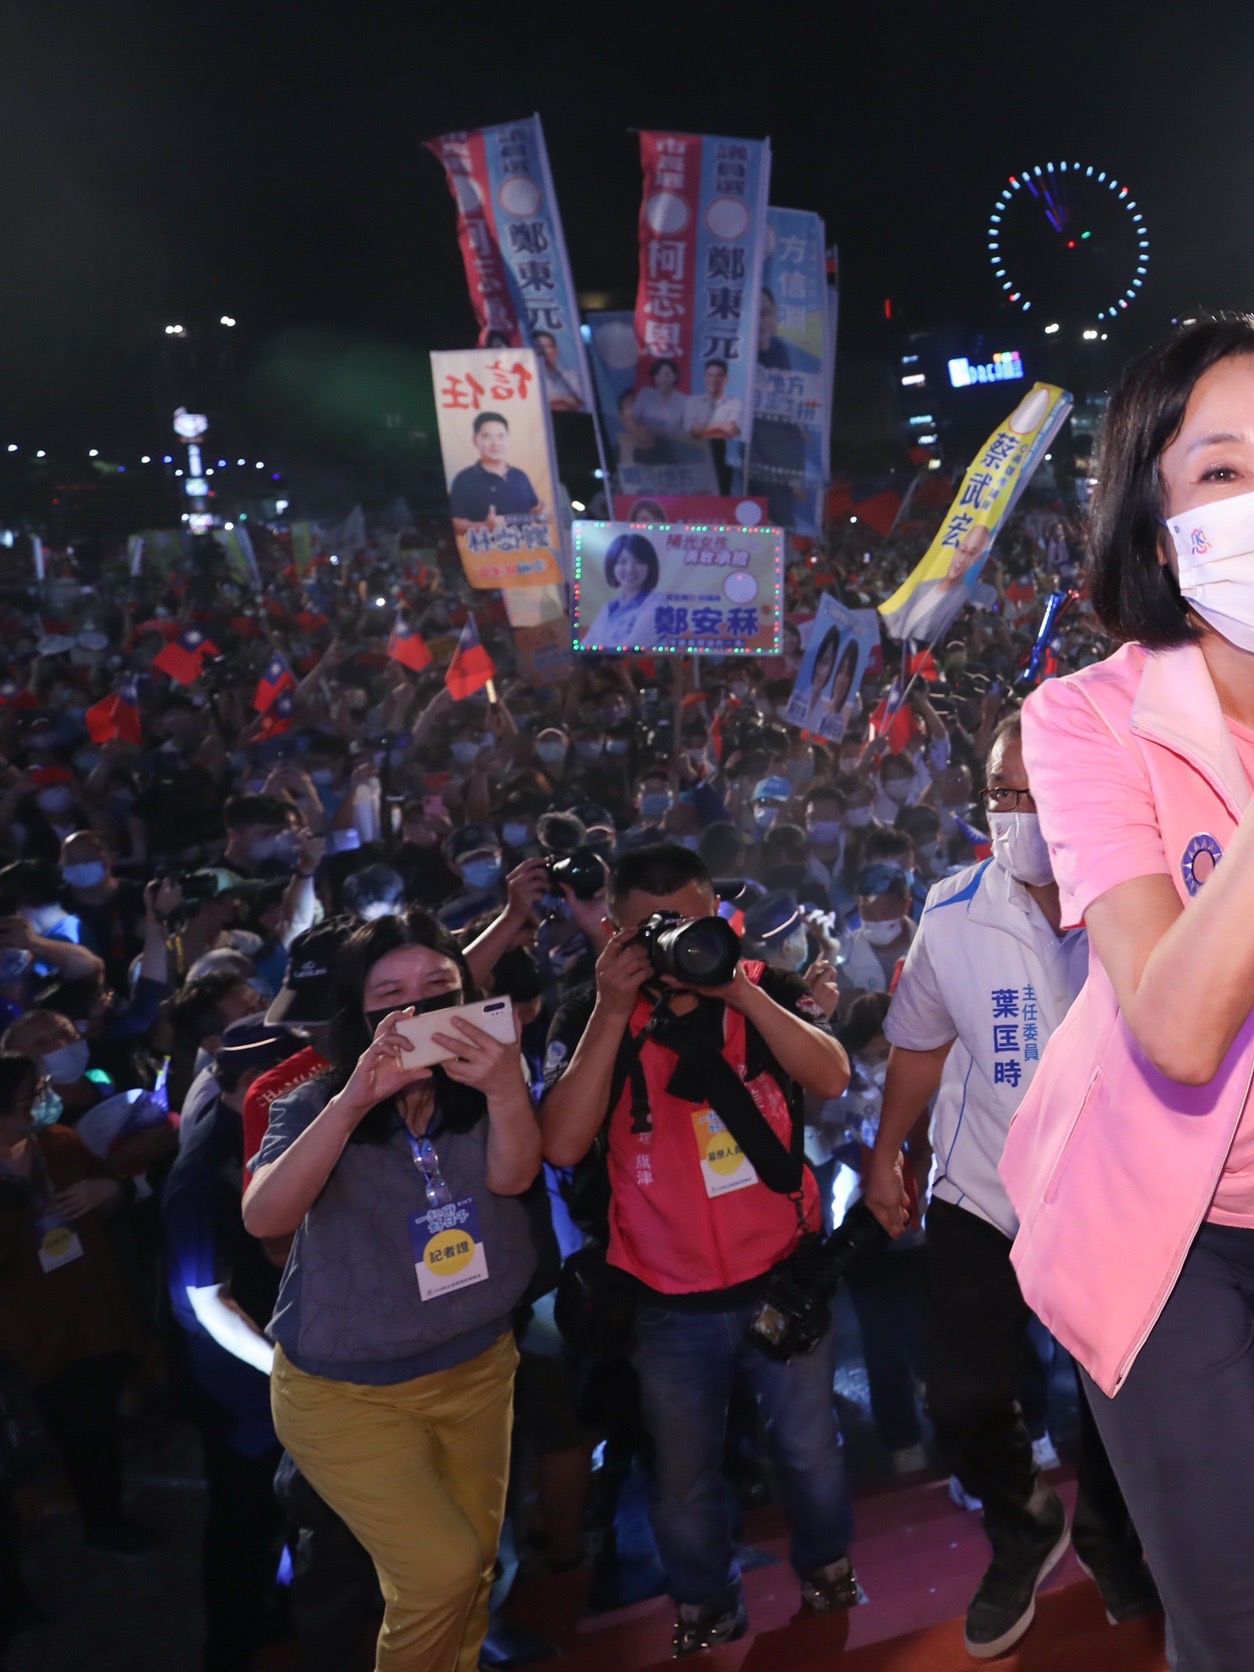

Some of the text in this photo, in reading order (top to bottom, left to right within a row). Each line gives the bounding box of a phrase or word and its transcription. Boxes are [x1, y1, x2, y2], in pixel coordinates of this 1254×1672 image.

[509, 221, 563, 330] 鄭東元
[642, 238, 689, 359] 柯志恩
[703, 245, 746, 361] 鄭東元
[941, 432, 1022, 548] 蔡武宏
[654, 606, 759, 636] 鄭安秝
[991, 988, 1022, 1088] 葉匡時
[1022, 984, 1039, 1062] 主任委員
[428, 1240, 471, 1264] 記者證
